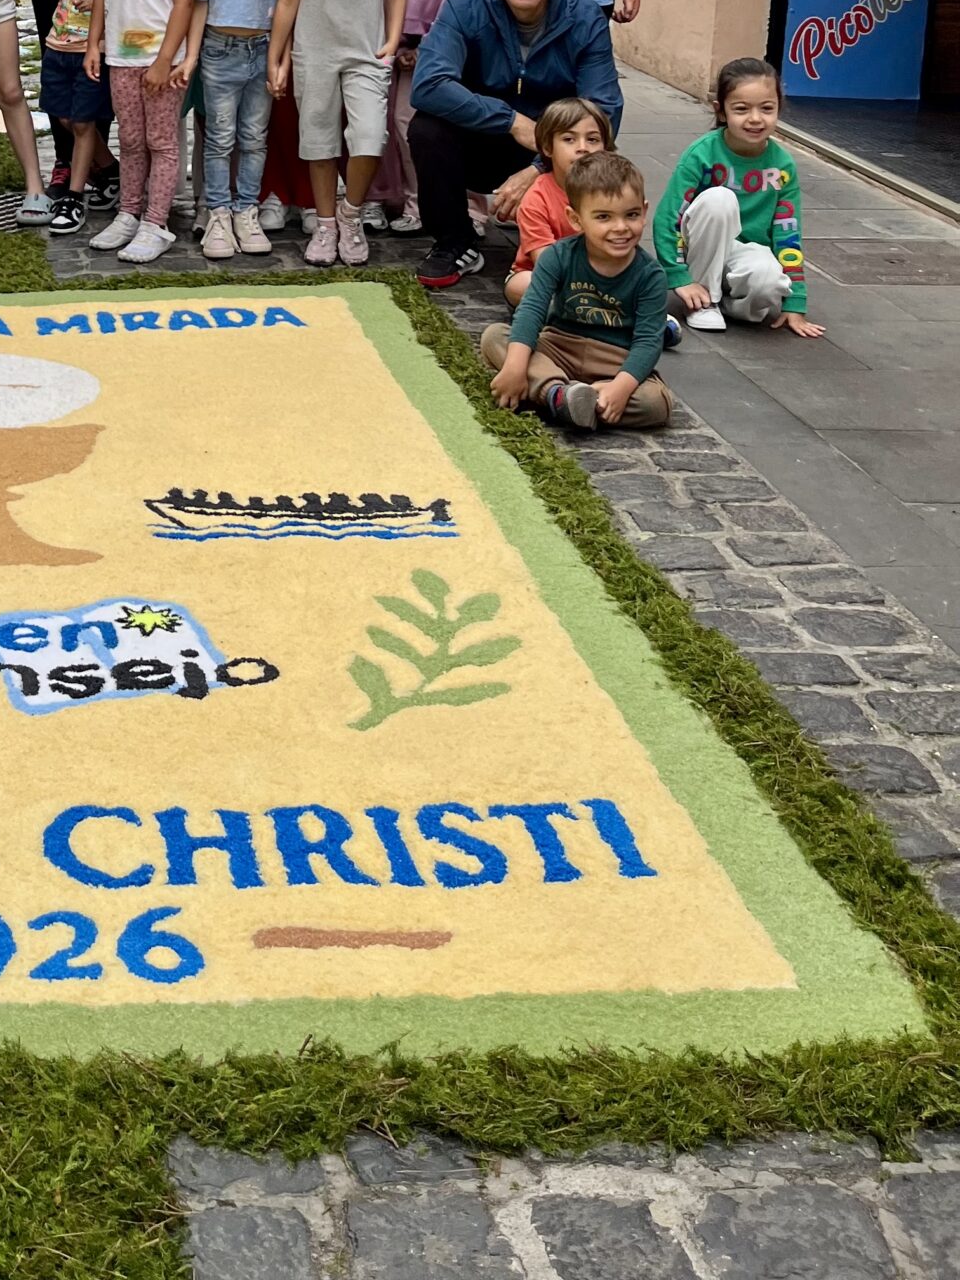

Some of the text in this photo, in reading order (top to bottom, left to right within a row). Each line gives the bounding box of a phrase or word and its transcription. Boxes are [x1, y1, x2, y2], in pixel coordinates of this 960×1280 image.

[570, 281, 596, 291] ROAD
[36, 306, 308, 337] MIRADA
[42, 798, 658, 890] CHRISTI
